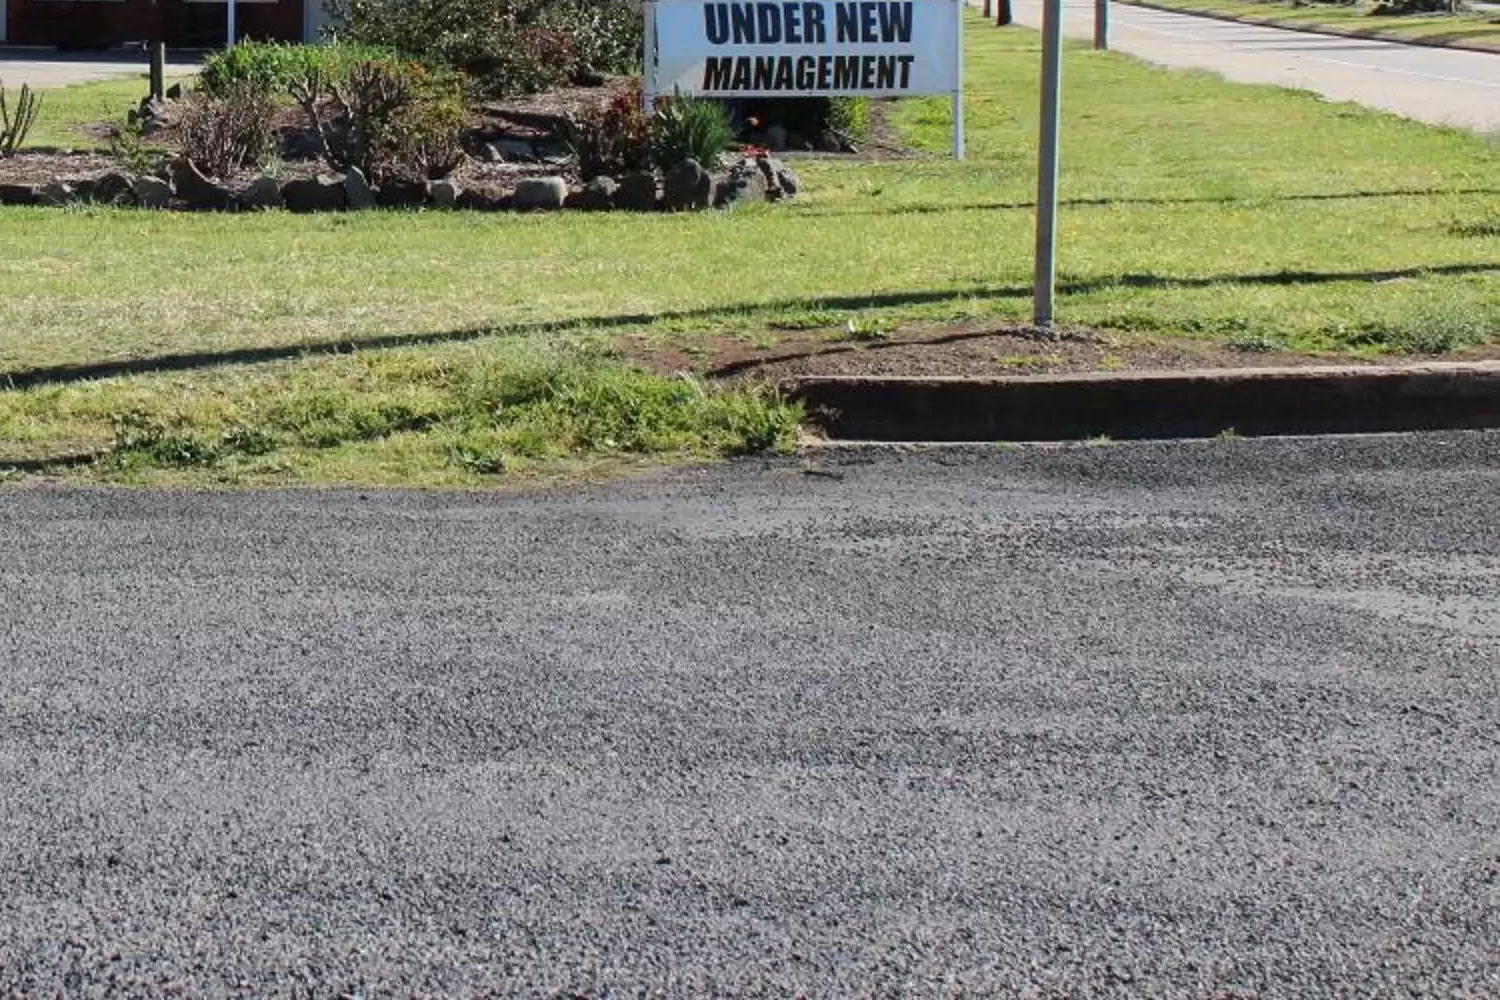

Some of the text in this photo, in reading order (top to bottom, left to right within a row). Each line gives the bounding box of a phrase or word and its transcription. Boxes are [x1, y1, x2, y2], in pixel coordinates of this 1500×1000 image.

[704, 1, 914, 44] UNDER NEW
[703, 55, 915, 91] MANAGEMENT
